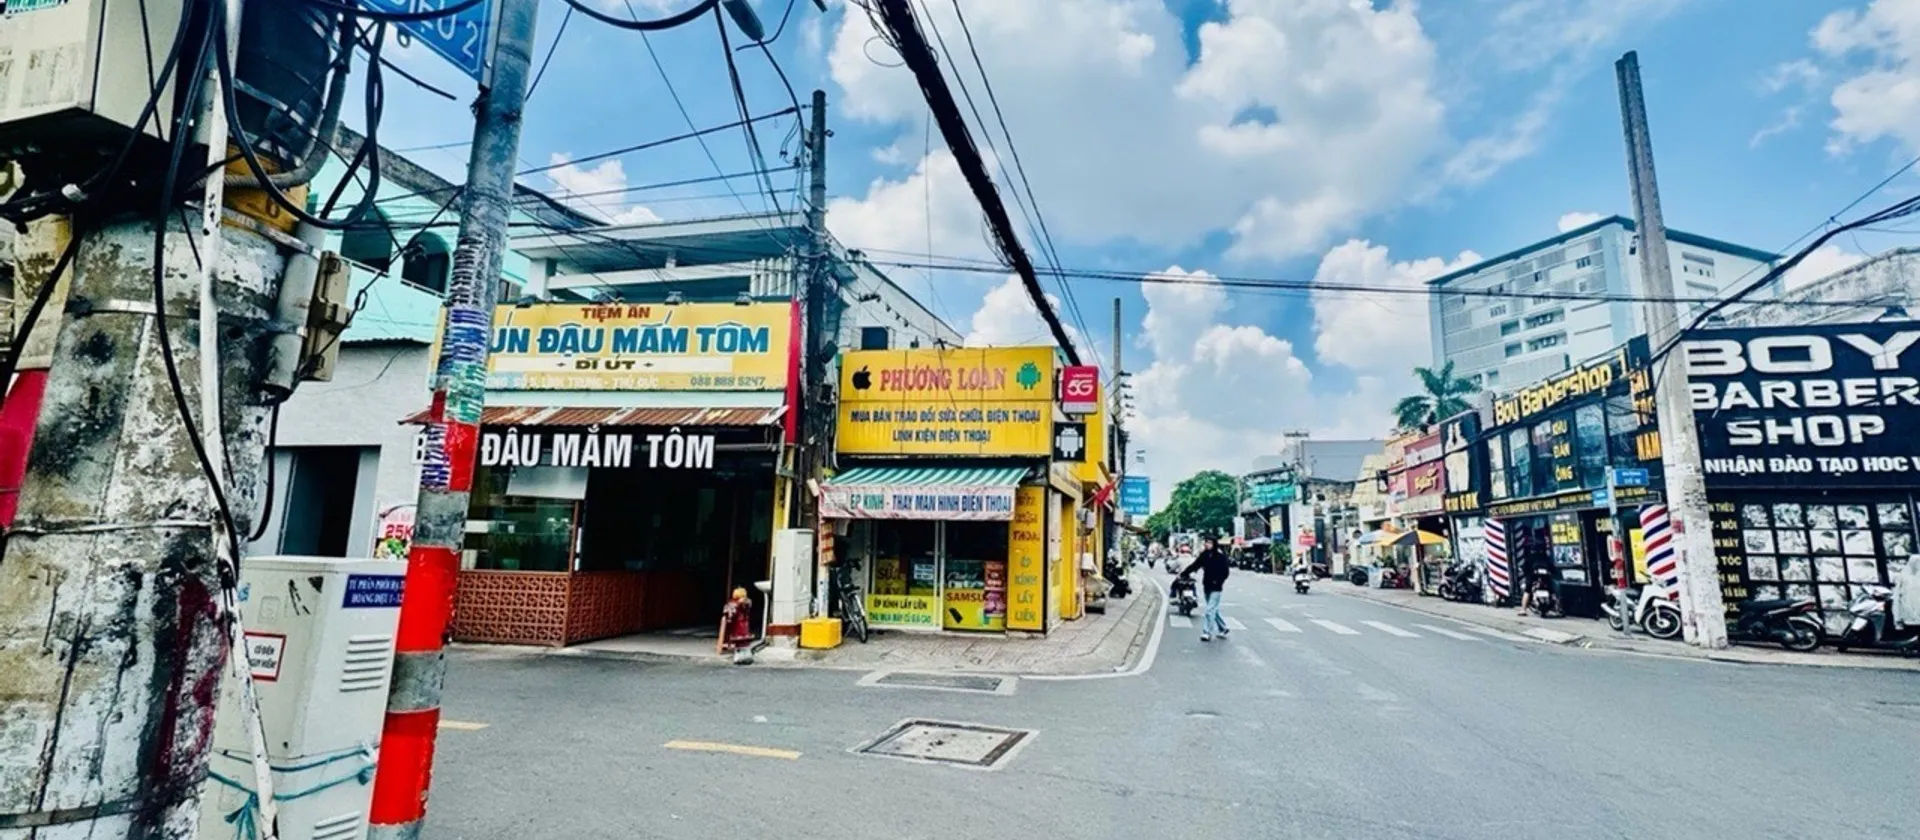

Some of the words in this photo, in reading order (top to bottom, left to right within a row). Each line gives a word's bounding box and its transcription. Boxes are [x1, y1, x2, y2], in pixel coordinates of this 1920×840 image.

[462, 21, 479, 58] 2
[581, 306, 622, 323] TIỆM
[488, 311, 531, 354] ÚN
[537, 323, 605, 358] ĐẬU
[611, 310, 690, 354] MẮM
[695, 321, 770, 354] TÔM
[1682, 330, 1920, 376] BOY
[1067, 379, 1094, 396] 5G
[1495, 398, 1521, 426] Boy
[1521, 361, 1613, 417] Barbershop
[1689, 377, 1920, 411] BARBER
[851, 410, 871, 422] MUA
[873, 407, 891, 422] BÁN
[987, 408, 1009, 424] ĐIỆN
[1012, 410, 1041, 425] THOẠI
[939, 428, 960, 444] ĐIỆN
[964, 430, 991, 445] THOẠI
[1726, 414, 1885, 446] SHOP
[646, 427, 715, 469] TÔM
[1704, 455, 1765, 477] NHẬN
[1769, 454, 1813, 473] ĐÀO
[1816, 456, 1859, 477] TẠO
[1720, 519, 1738, 530] MÔI
[1720, 554, 1742, 566] TÓC
